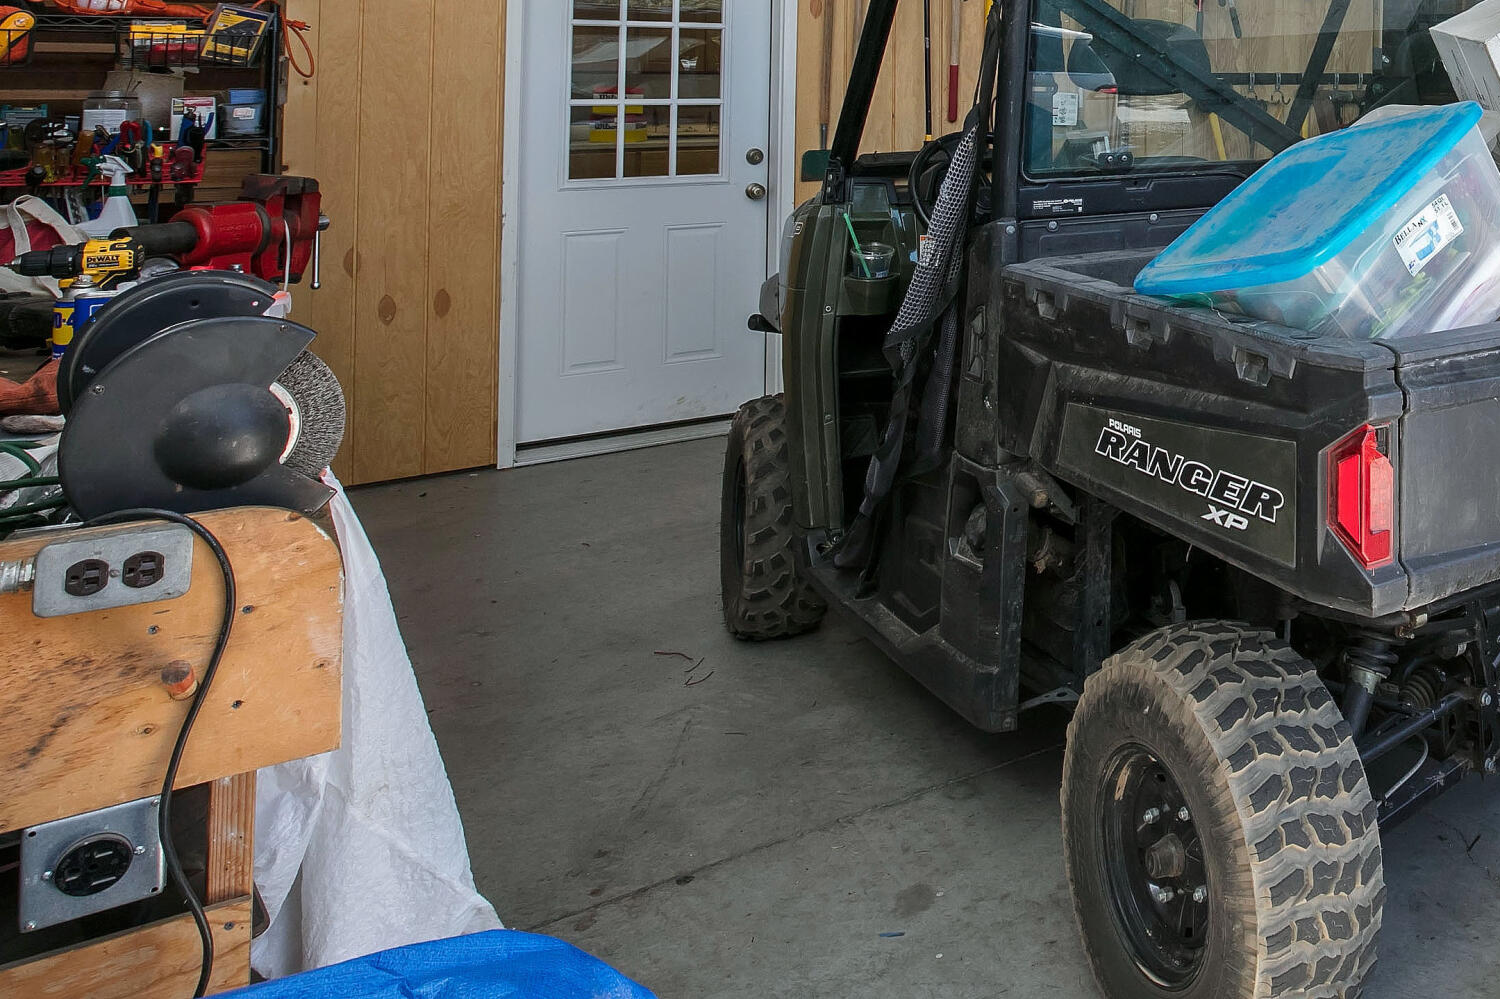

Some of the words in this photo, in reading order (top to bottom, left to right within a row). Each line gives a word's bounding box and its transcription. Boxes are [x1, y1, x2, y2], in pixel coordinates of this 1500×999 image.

[1109, 418, 1141, 439] POLARIS
[1095, 427, 1285, 524] RANGER
[1201, 504, 1249, 531] XP
